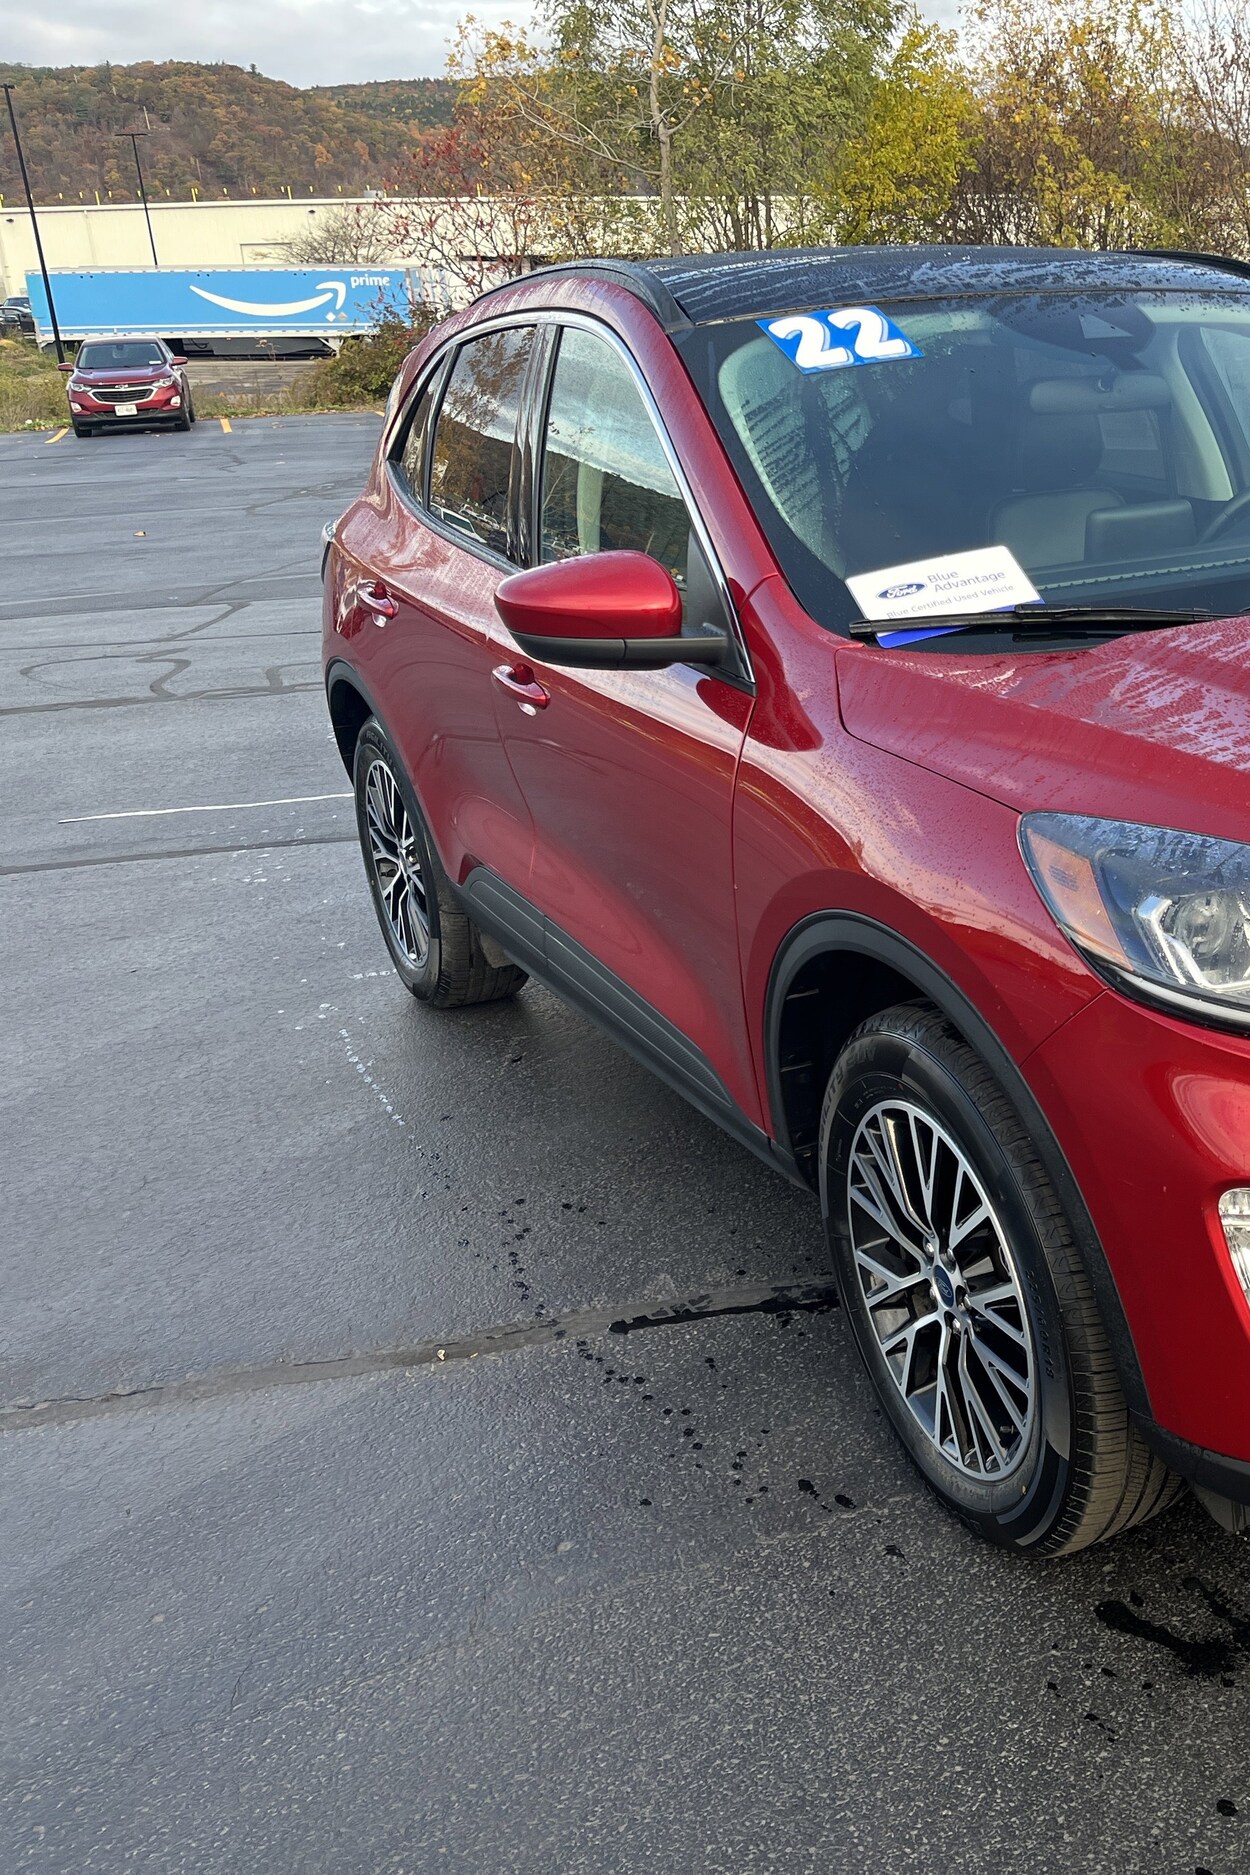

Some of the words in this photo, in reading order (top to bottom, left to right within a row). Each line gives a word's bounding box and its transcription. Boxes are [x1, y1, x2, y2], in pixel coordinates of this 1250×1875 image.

[350, 274, 390, 288] prime
[768, 309, 912, 368] 22
[927, 570, 959, 584] Blue
[934, 571, 1006, 593] Advantage
[887, 585, 919, 599] Ford
[886, 608, 909, 619] Blue
[912, 597, 952, 612] Certified
[954, 592, 979, 603] Used
[981, 584, 1014, 597] Vehicle
